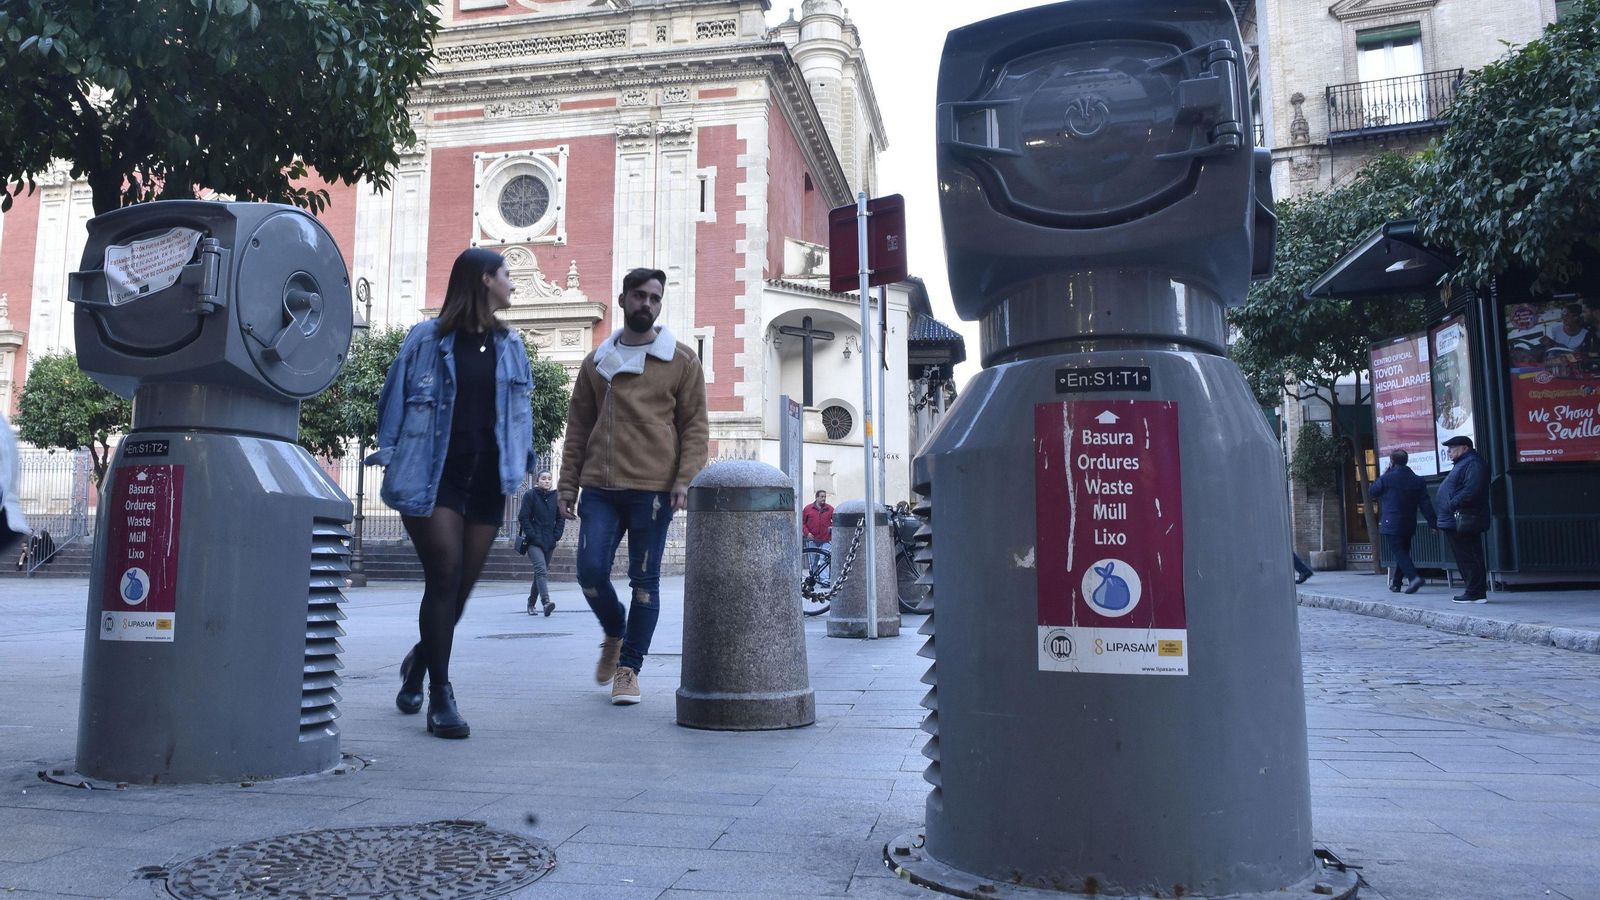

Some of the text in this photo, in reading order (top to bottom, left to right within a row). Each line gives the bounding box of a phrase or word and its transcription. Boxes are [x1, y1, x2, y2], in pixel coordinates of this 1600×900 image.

[1374, 351, 1412, 366] CENTRO OFICIAL
[1375, 364, 1403, 379] TOYOTA
[1528, 407, 1550, 423] We
[1553, 405, 1594, 421] Show
[1546, 418, 1600, 440] Seville
[1082, 429, 1134, 445] Basura
[1077, 453, 1139, 470] Ordures
[128, 484, 154, 495] Basura
[1085, 479, 1133, 494] Waste
[125, 499, 156, 511] Ordures
[1093, 503, 1127, 520] Müll
[127, 516, 151, 526] Waste
[128, 531, 147, 543] Müll
[1094, 529, 1127, 545] Lixo
[128, 548, 145, 559] Lixo
[128, 620, 154, 628] LIPASAM
[1106, 643, 1155, 652] LIPASAM
